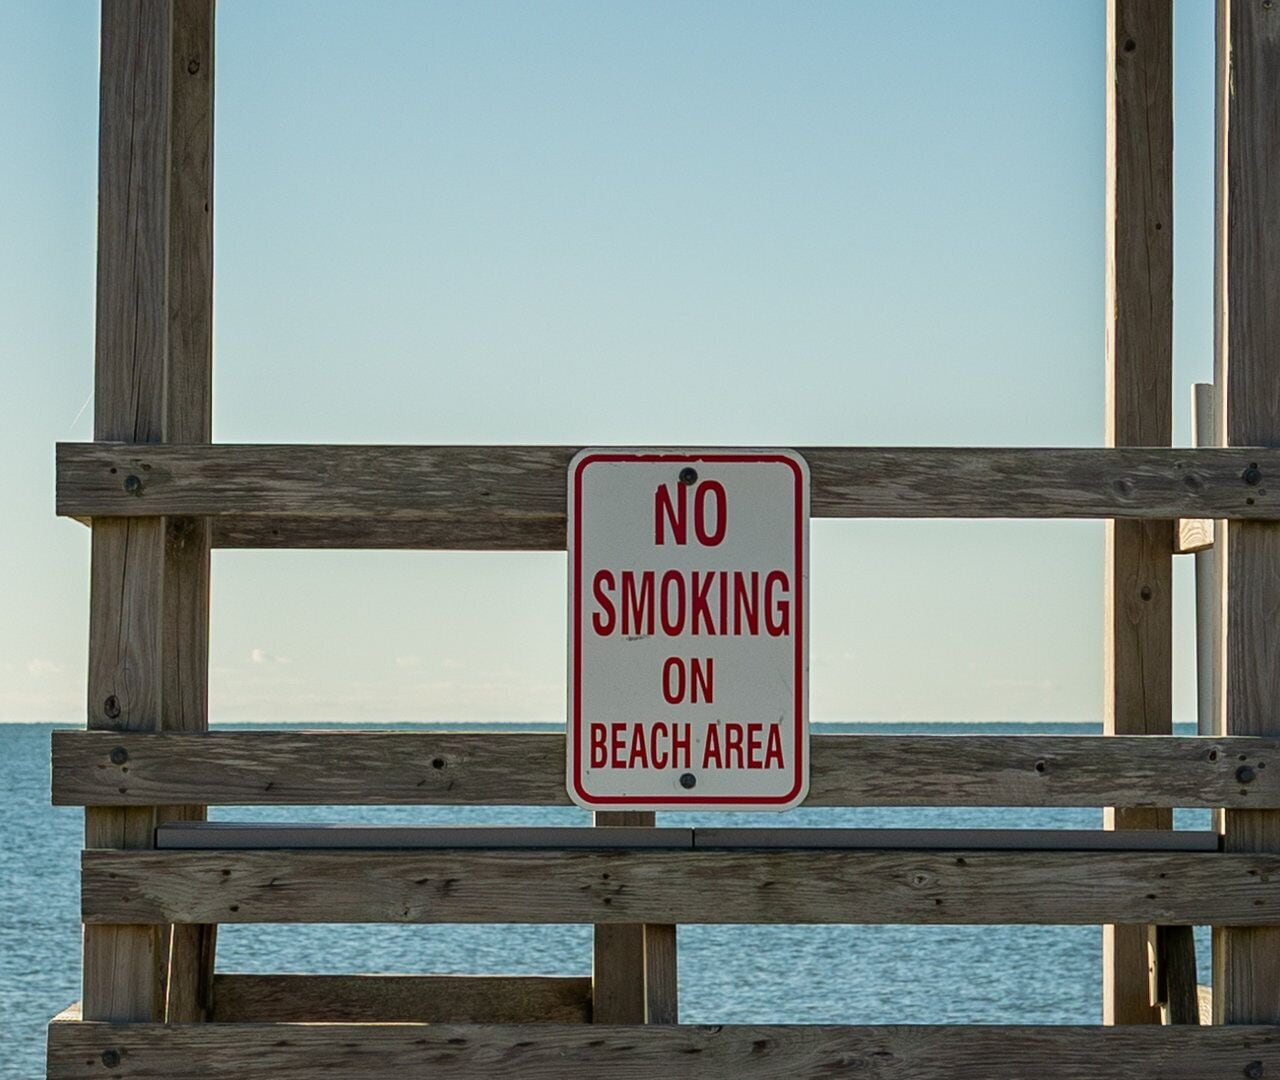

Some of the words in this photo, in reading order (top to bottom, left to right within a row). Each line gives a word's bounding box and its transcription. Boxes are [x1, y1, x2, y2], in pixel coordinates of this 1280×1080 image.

[654, 480, 727, 547] NO
[592, 569, 790, 637] SMOKING
[662, 656, 714, 705] ON
[590, 722, 691, 769] BEACH
[702, 723, 785, 769] AREA
